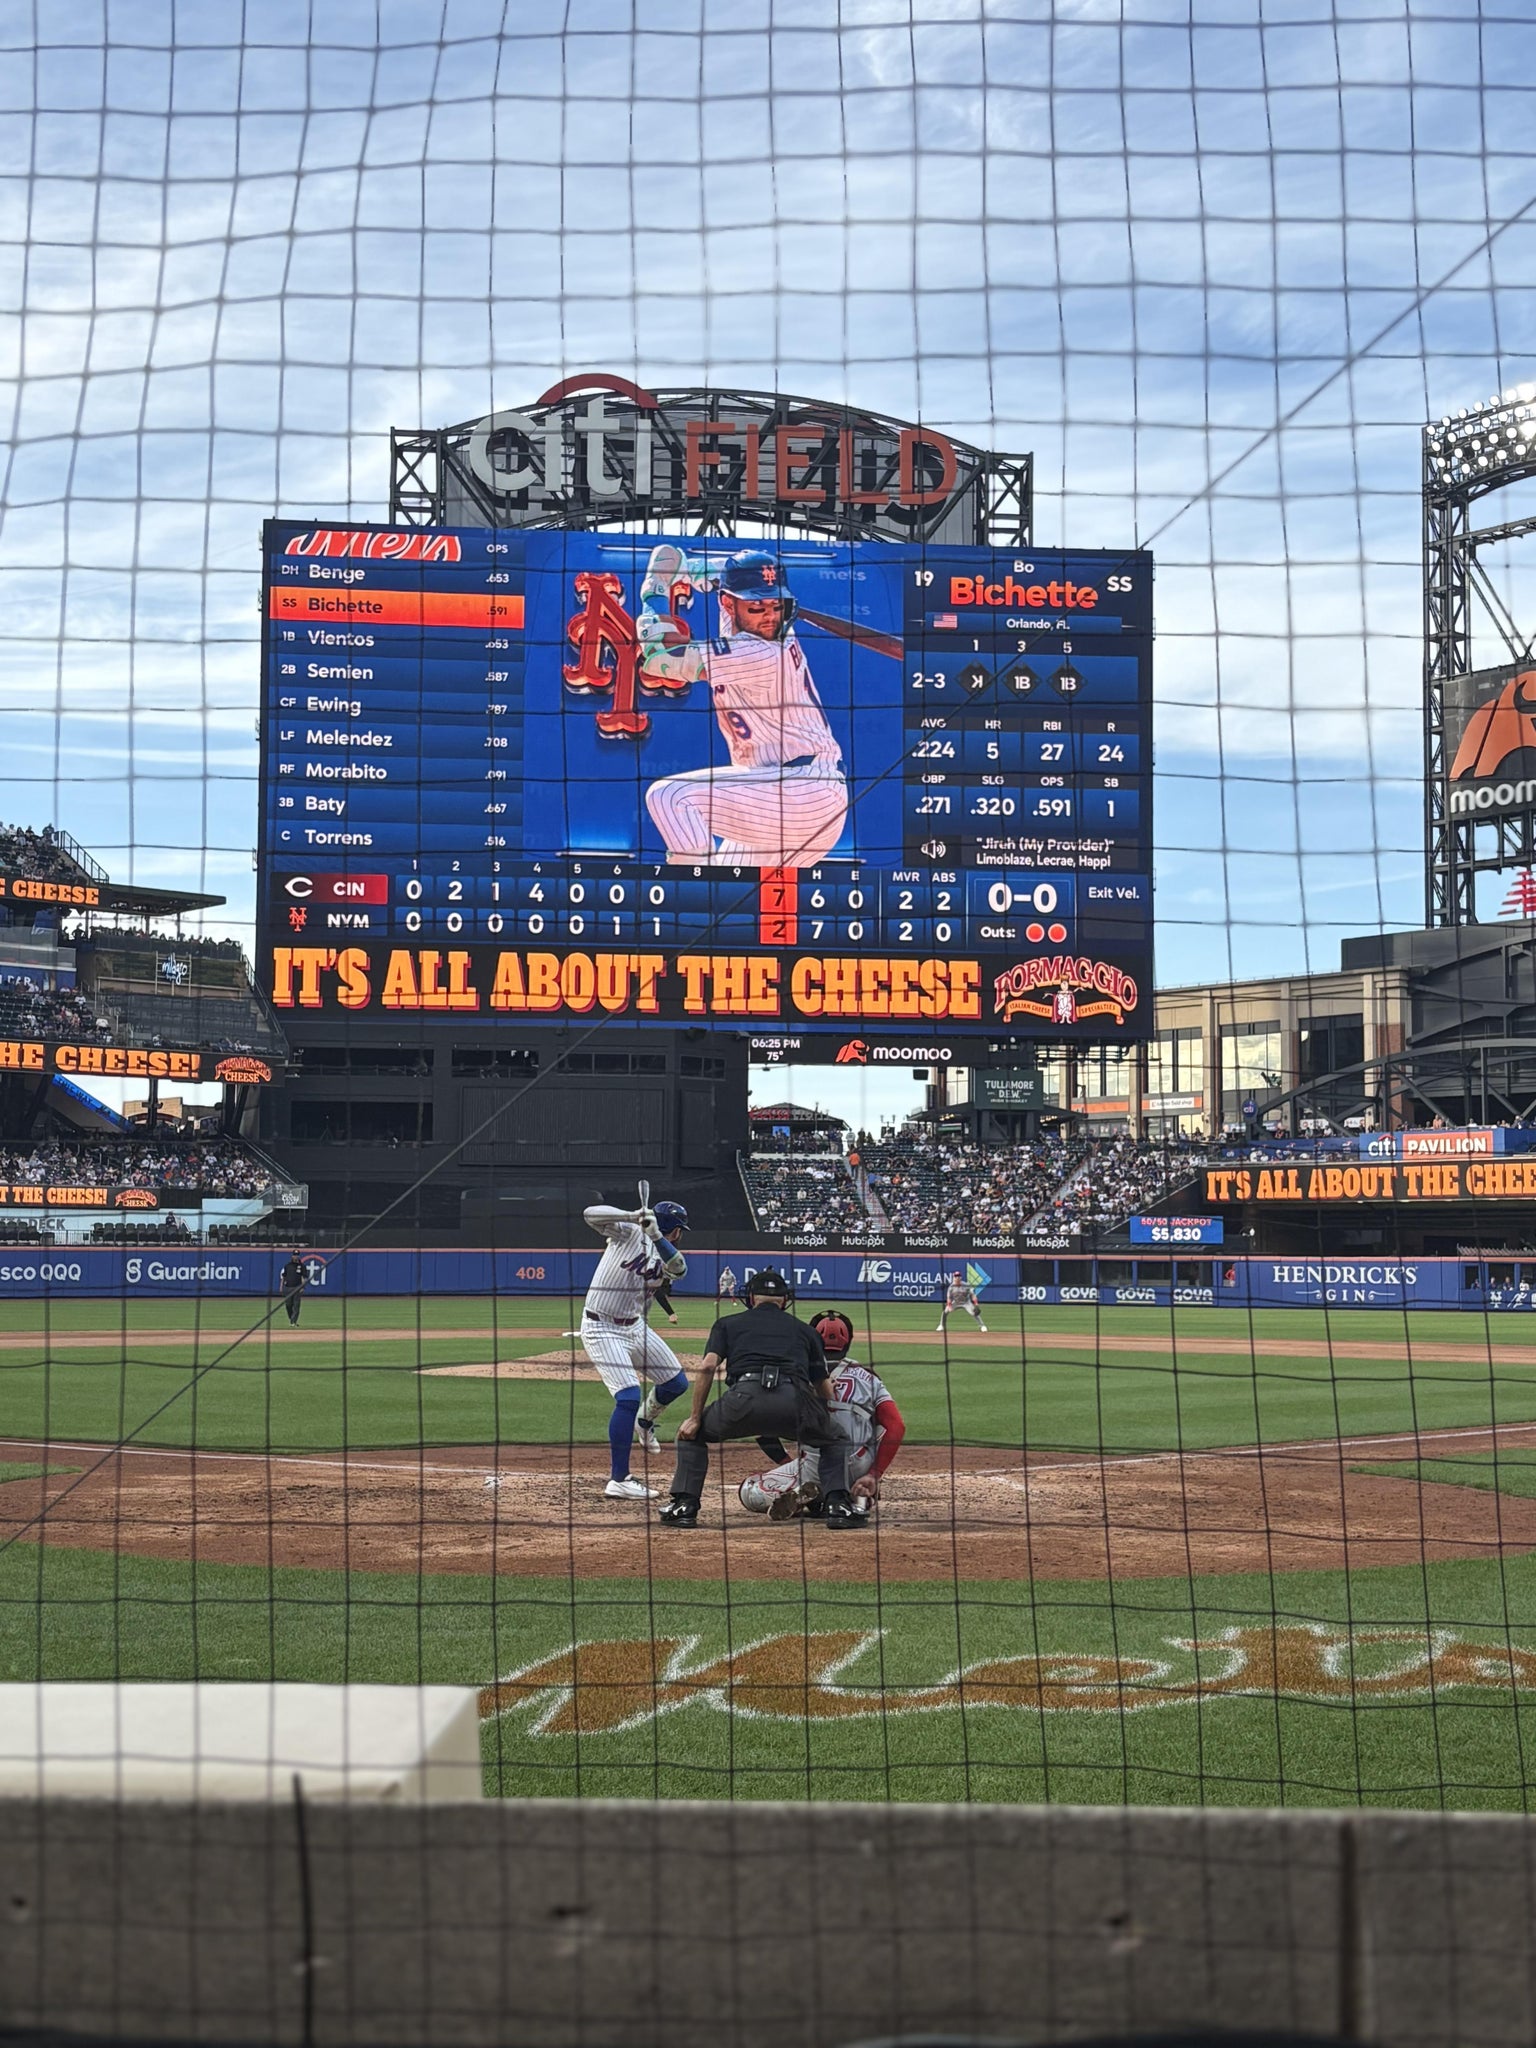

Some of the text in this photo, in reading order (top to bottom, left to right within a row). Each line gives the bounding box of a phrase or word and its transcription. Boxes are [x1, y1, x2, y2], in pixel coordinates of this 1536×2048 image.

[470, 395, 958, 505] citi FIELD
[487, 544, 508, 553] OPS
[282, 564, 509, 584] DH Benge .653
[1014, 560, 1034, 573] Bo
[915, 571, 934, 586] 19
[1107, 576, 1132, 592] SS
[951, 575, 1098, 609] Bichette
[282, 598, 508, 616] SS Bichette .591
[1007, 618, 1054, 631] Orlando,
[283, 631, 374, 647] 1B Vientos
[973, 640, 1072, 653] 1 3 5
[281, 665, 296, 674] 2B
[308, 663, 373, 680] Semien
[912, 673, 1076, 691] 2-3 1B 1B
[280, 698, 296, 707] CF
[307, 697, 361, 717] Ewing
[921, 718, 1115, 732] AVG HR RBI R
[281, 730, 508, 747] LF Melendez .708
[912, 741, 1124, 762] .224 5 27 24
[280, 763, 387, 780] RF Morabito
[921, 774, 1118, 788] OBP SLG OPS SB
[279, 798, 294, 807] 3B
[306, 796, 345, 815] Baty
[915, 797, 1114, 817] .271 .320 .591 1
[281, 831, 291, 840] C
[305, 829, 372, 846] Torrens
[1019, 837, 1044, 853] (My
[977, 853, 1110, 870] Limoblaze, Lecrae, Happi
[412, 860, 956, 883] 1 2 3 4 5 6 7 8 9 R H E MVR ABS
[12, 880, 99, 905] CHEESE
[333, 880, 950, 910] CIN 0 2 1 4 0 0 0 7 6 0 2 2
[988, 882, 1058, 913] 0-0
[1088, 887, 1139, 899] Exit Vel.
[327, 912, 951, 942] NYM 0 0 0 0 0 1 1 2 7 0 2 0
[980, 926, 1016, 938] Outs:
[273, 947, 982, 1019] IT'S ALL ABOUT THE CHEESE
[994, 955, 1137, 1014] FORMAGGIO
[752, 1039, 800, 1048] 06:25 PM
[54, 1044, 201, 1079] CHEESE!
[767, 1051, 784, 1061] 75°
[873, 1047, 952, 1060] moomoo
[225, 1073, 260, 1083] CHEESE
[984, 1080, 1034, 1089] TULLAMORE
[1368, 1138, 1486, 1156] citi PAVILION
[1207, 1170, 1250, 1201] IT'S
[1256, 1169, 1302, 1200] ALL
[1308, 1167, 1397, 1199] ABOUT
[1403, 1165, 1459, 1197] THE
[12, 1187, 43, 1204] THE
[46, 1187, 108, 1204] CHEESE!
[1170, 1218, 1212, 1226] JACKPOT
[784, 1234, 827, 1247] HubSpot
[842, 1234, 885, 1247] HubSpot
[905, 1235, 948, 1248] HubSpot
[973, 1236, 1015, 1249] HubSpot
[1027, 1236, 1070, 1249] HubSpot
[1152, 1227, 1201, 1242] $5,830
[40, 1264, 82, 1281] QQQ
[148, 1261, 240, 1280] Guardian
[516, 1266, 545, 1280] 408
[745, 1268, 823, 1285] DLTA
[893, 1272, 953, 1284] HAUGLAN
[1273, 1265, 1418, 1285] HENDRICK'S
[893, 1285, 935, 1297] GROUP
[1018, 1287, 1046, 1300] 380
[1060, 1287, 1099, 1299] GOYA
[1116, 1288, 1156, 1299] GOYA
[1173, 1289, 1212, 1300] GOYA
[1326, 1289, 1365, 1302] GIN
